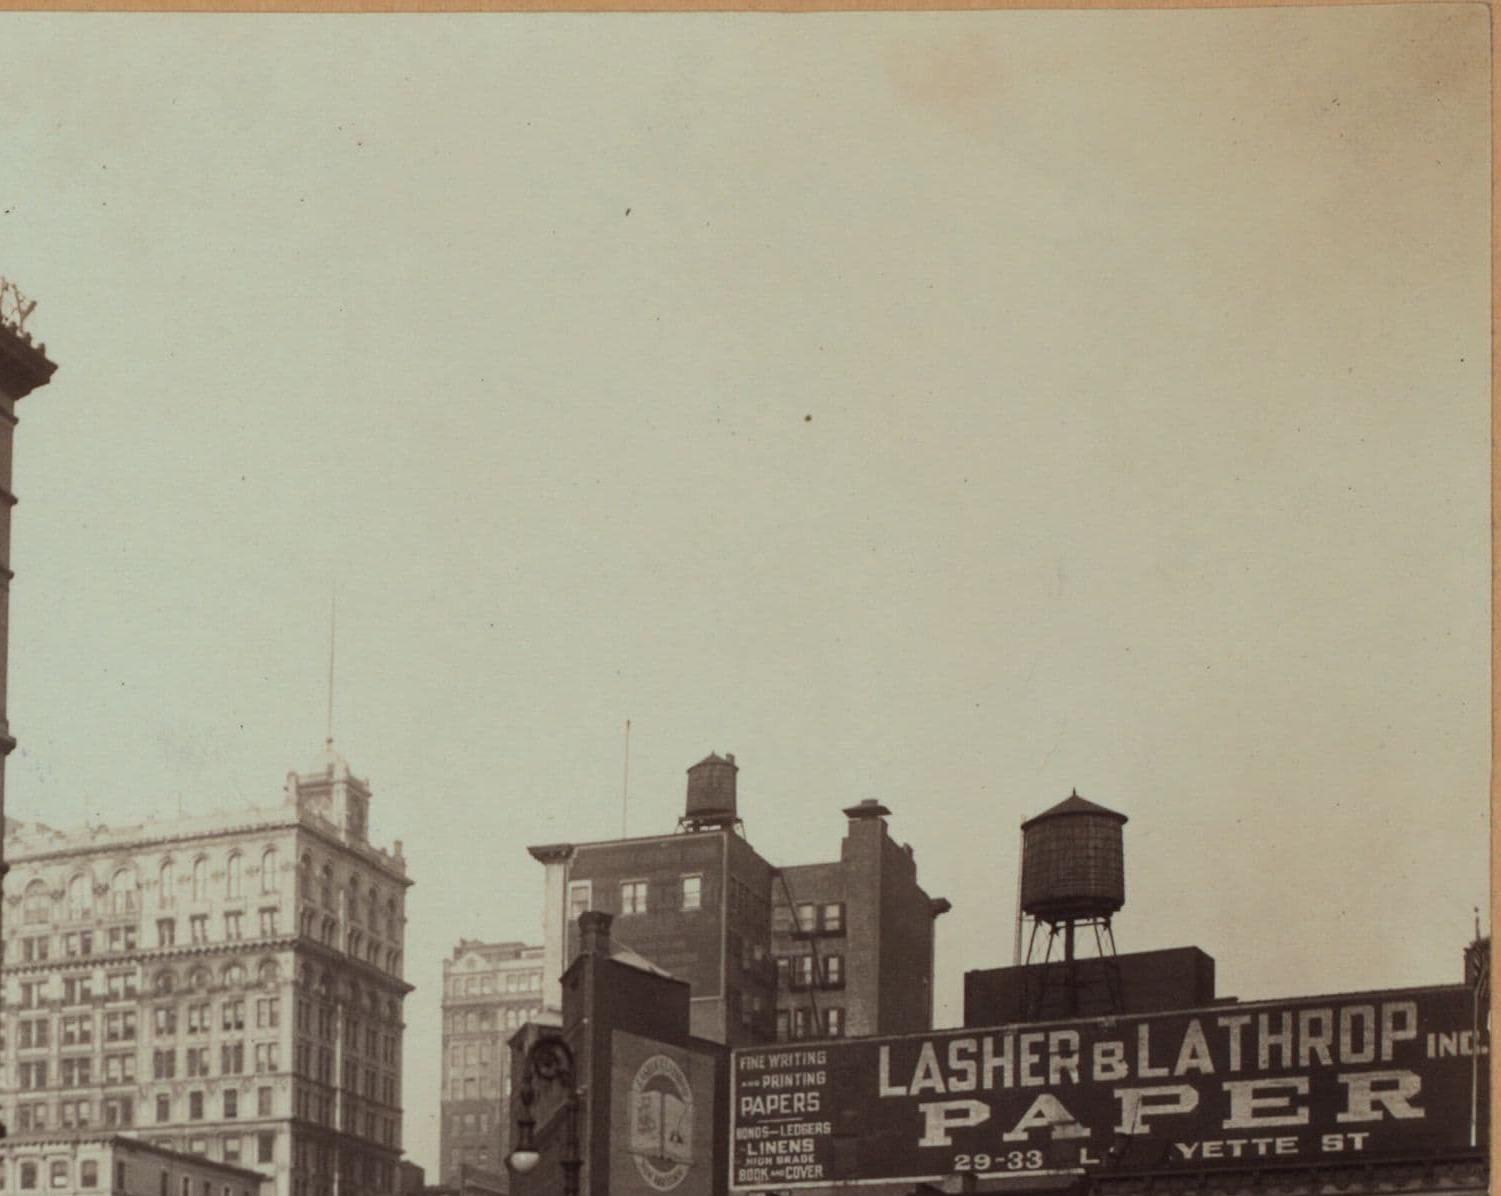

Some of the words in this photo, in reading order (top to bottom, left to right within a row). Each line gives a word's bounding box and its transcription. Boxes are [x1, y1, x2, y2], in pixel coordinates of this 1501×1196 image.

[879, 1030, 1080, 1097] LASHER
[1138, 1001, 1418, 1078] LATHROP
[739, 1055, 766, 1070] FINE
[768, 1050, 827, 1068] WRITING
[762, 1071, 827, 1089] PRINTING
[740, 1091, 821, 1117] PAPERS
[918, 1070, 1426, 1147] PAPER
[746, 1138, 815, 1156] LINENS
[954, 1150, 1043, 1171] 29-33
[1321, 1132, 1370, 1152] ST
[776, 1154, 815, 1165] GRADE
[738, 1167, 770, 1182] BOOK
[785, 1165, 824, 1180] COVER
